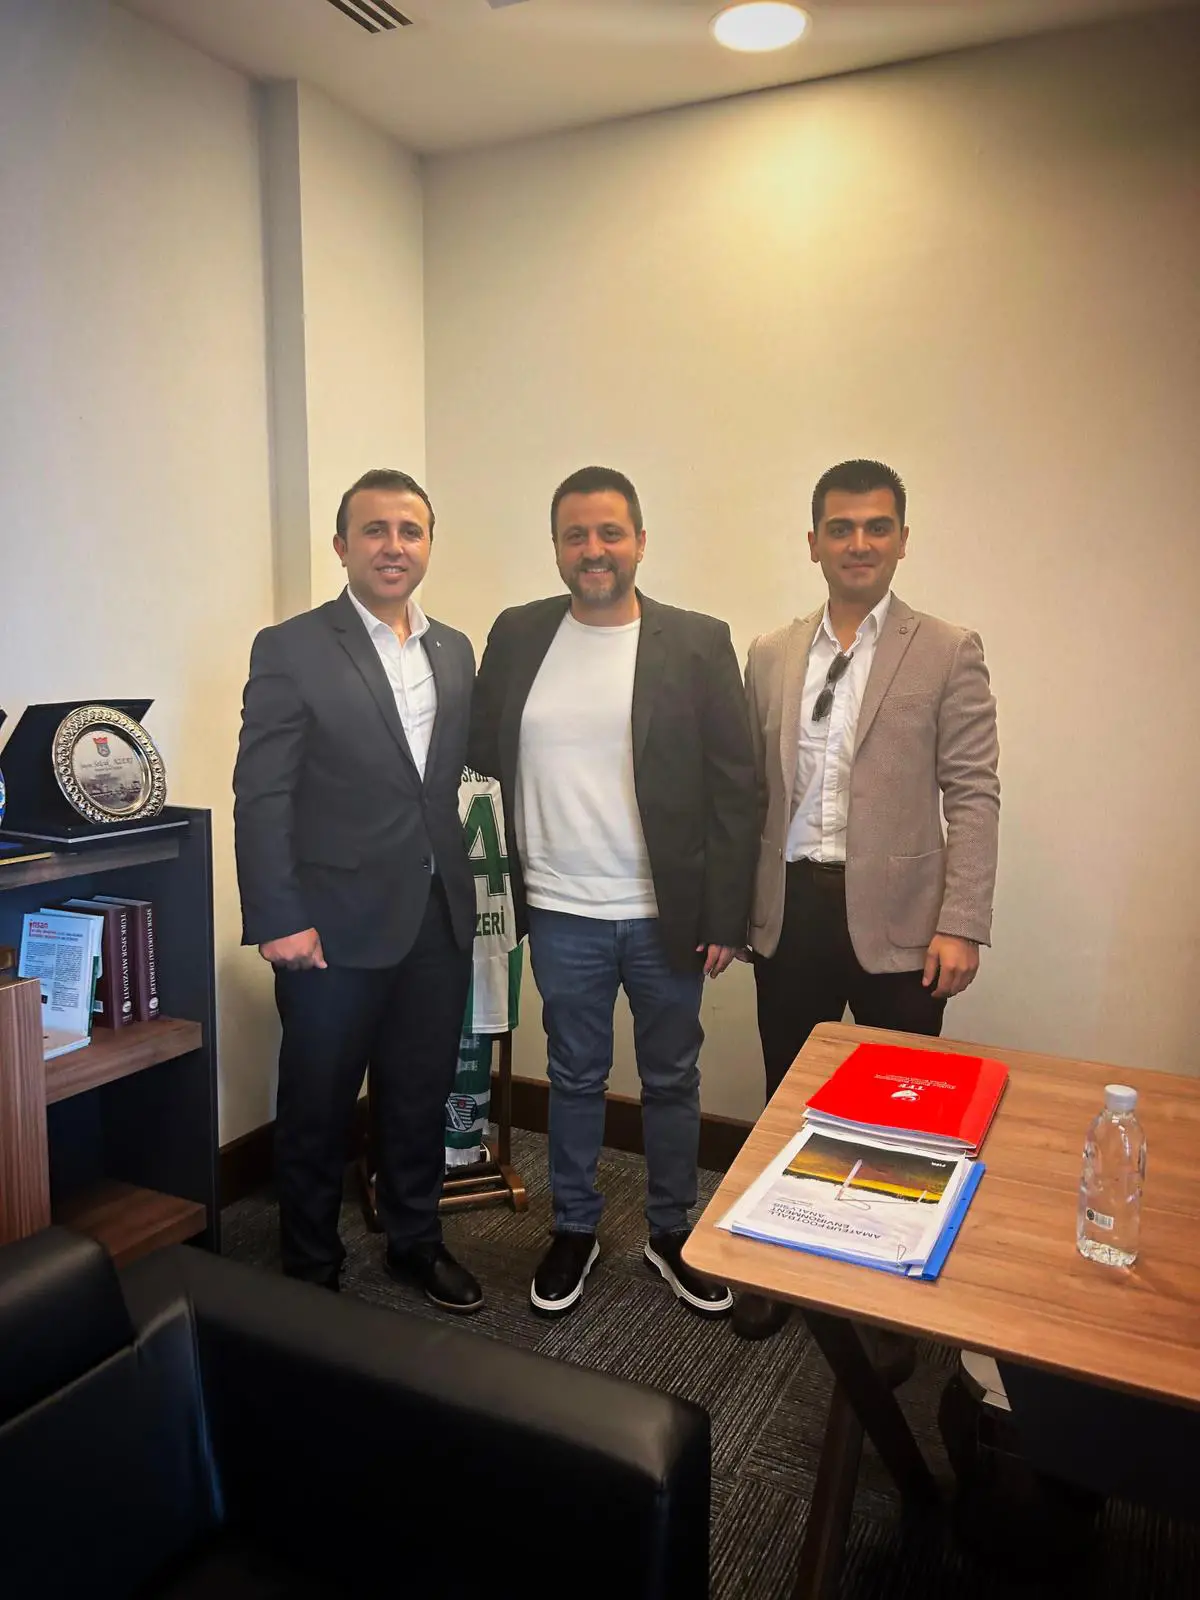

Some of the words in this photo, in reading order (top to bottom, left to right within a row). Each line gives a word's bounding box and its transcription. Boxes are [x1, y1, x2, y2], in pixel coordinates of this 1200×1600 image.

[121, 936, 129, 958] SPOR
[898, 1083, 925, 1091] TFF
[768, 1209, 826, 1229] FOOTBALL
[772, 1206, 850, 1229] ENVIRONMENT
[773, 1202, 825, 1218] ANALYSIS
[826, 1226, 881, 1239] AMATEUR
